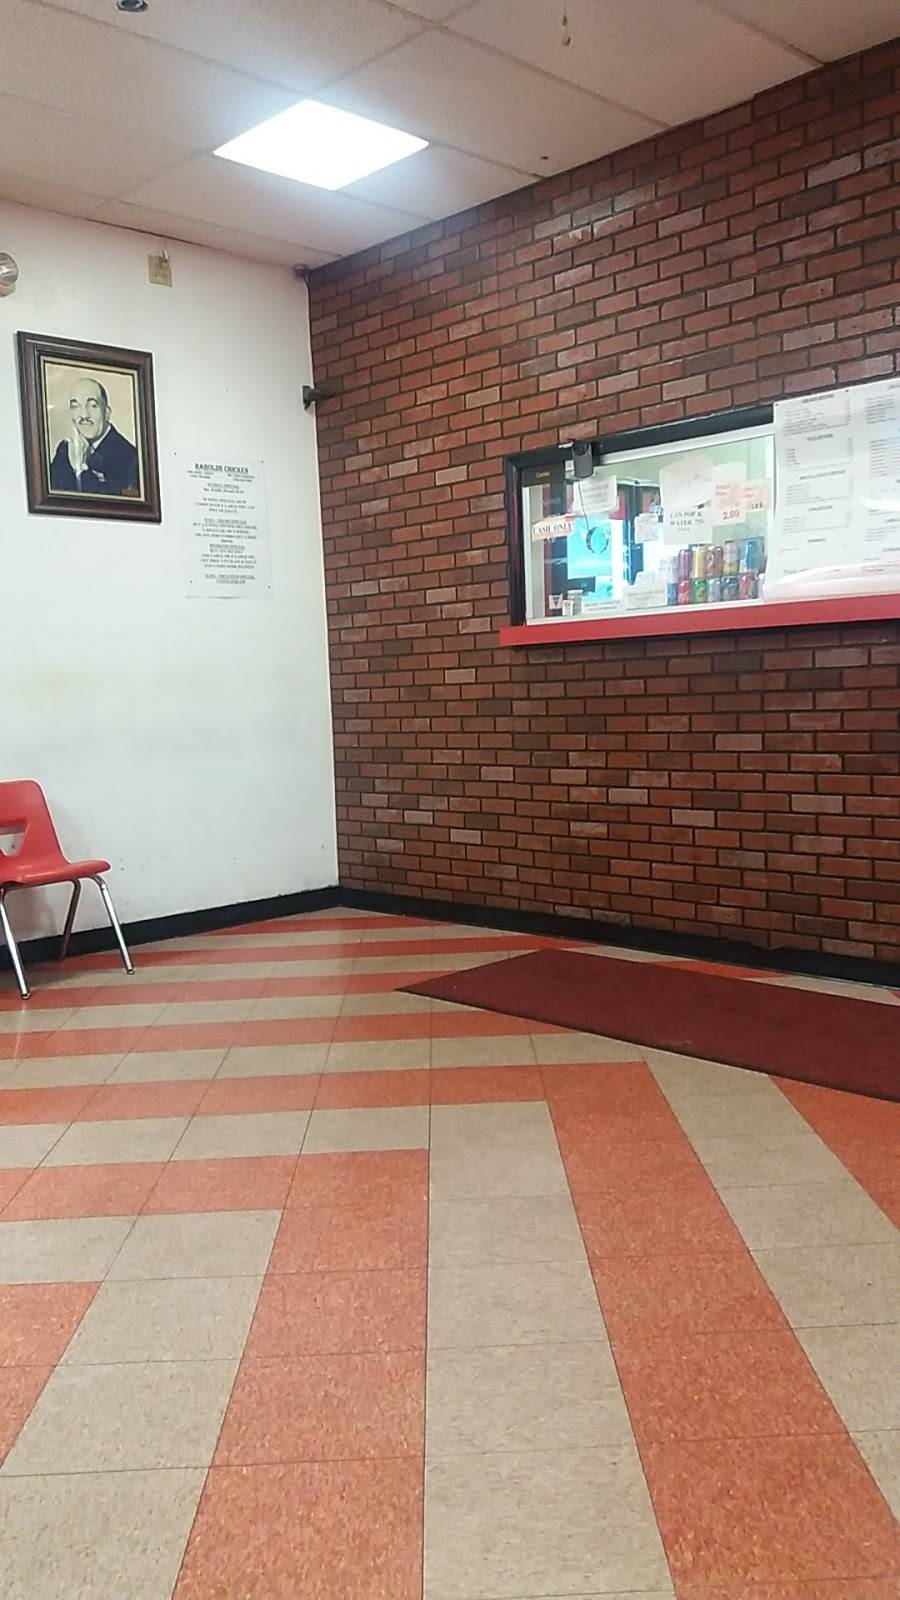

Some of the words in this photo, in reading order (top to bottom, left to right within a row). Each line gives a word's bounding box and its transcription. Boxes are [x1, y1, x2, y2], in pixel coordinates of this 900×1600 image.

[722, 509, 740, 520] 2.99
[533, 524, 552, 534] CASH
[553, 523, 572, 532] ONLY
